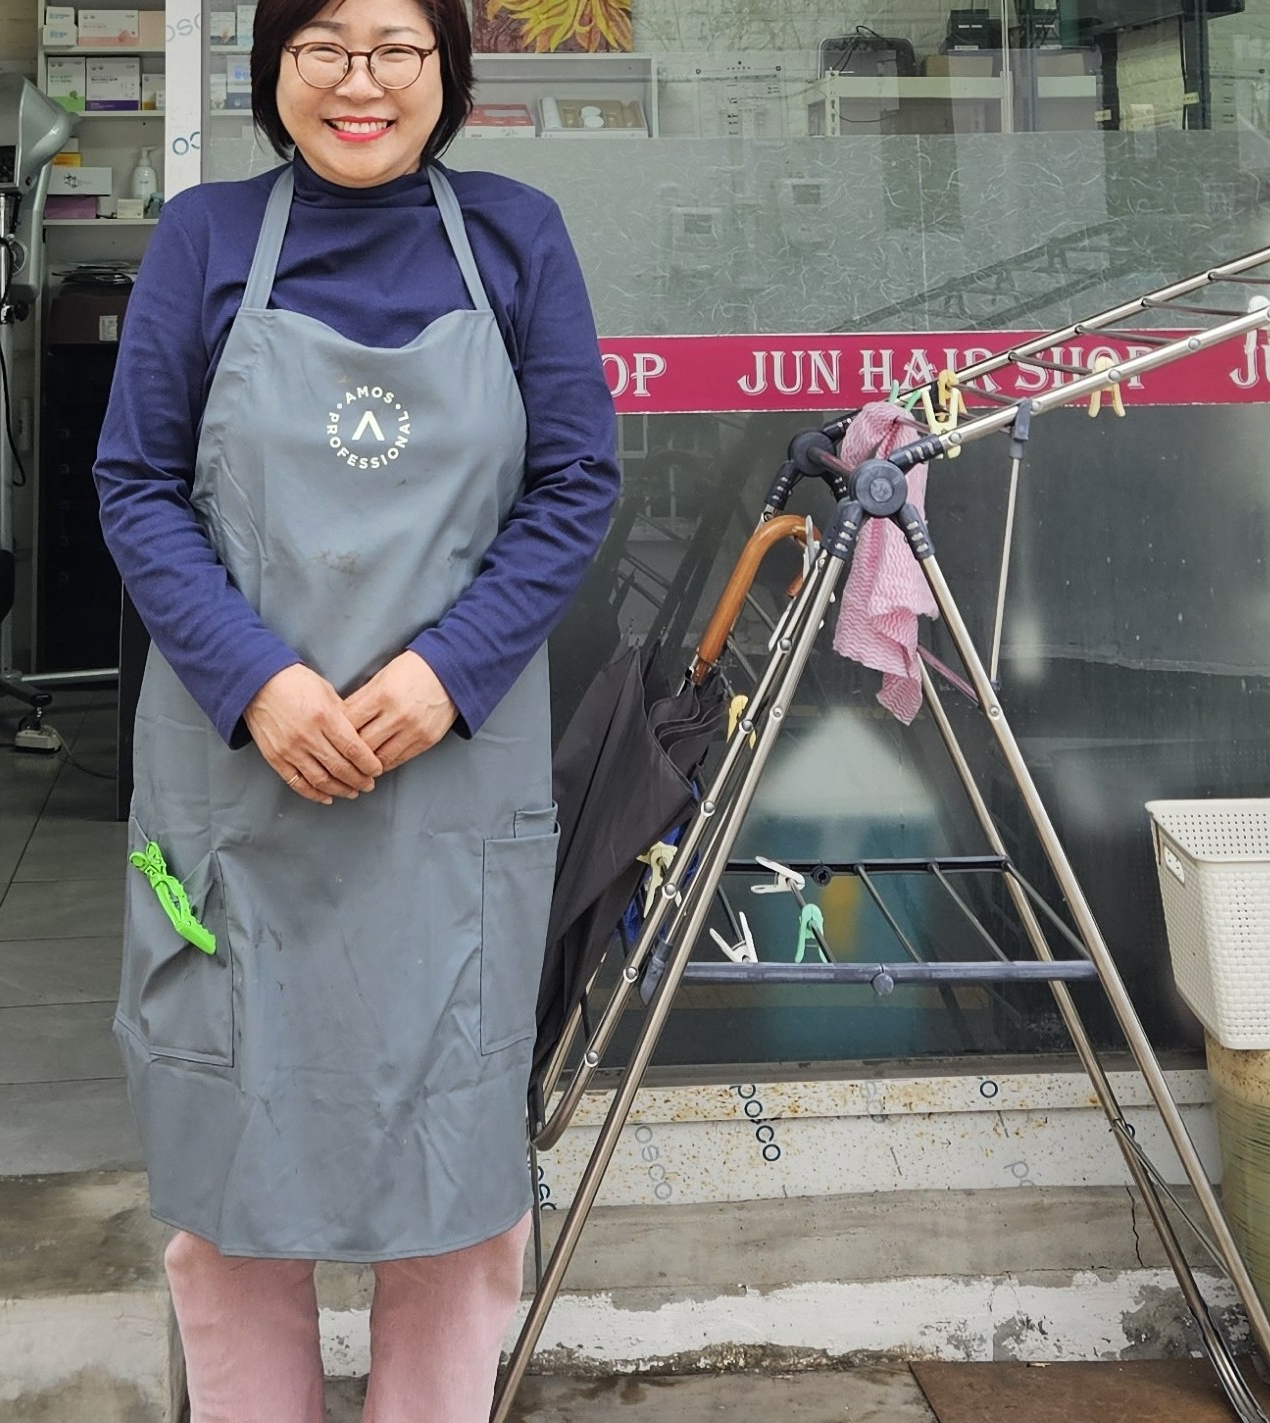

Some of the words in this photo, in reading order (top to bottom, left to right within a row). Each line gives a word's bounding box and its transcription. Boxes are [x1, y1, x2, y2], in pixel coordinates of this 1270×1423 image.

[345, 385, 395, 404] AMOS
[601, 352, 667, 398] OP
[737, 349, 842, 396] JUN
[326, 410, 411, 469] PROFESSIONAL
